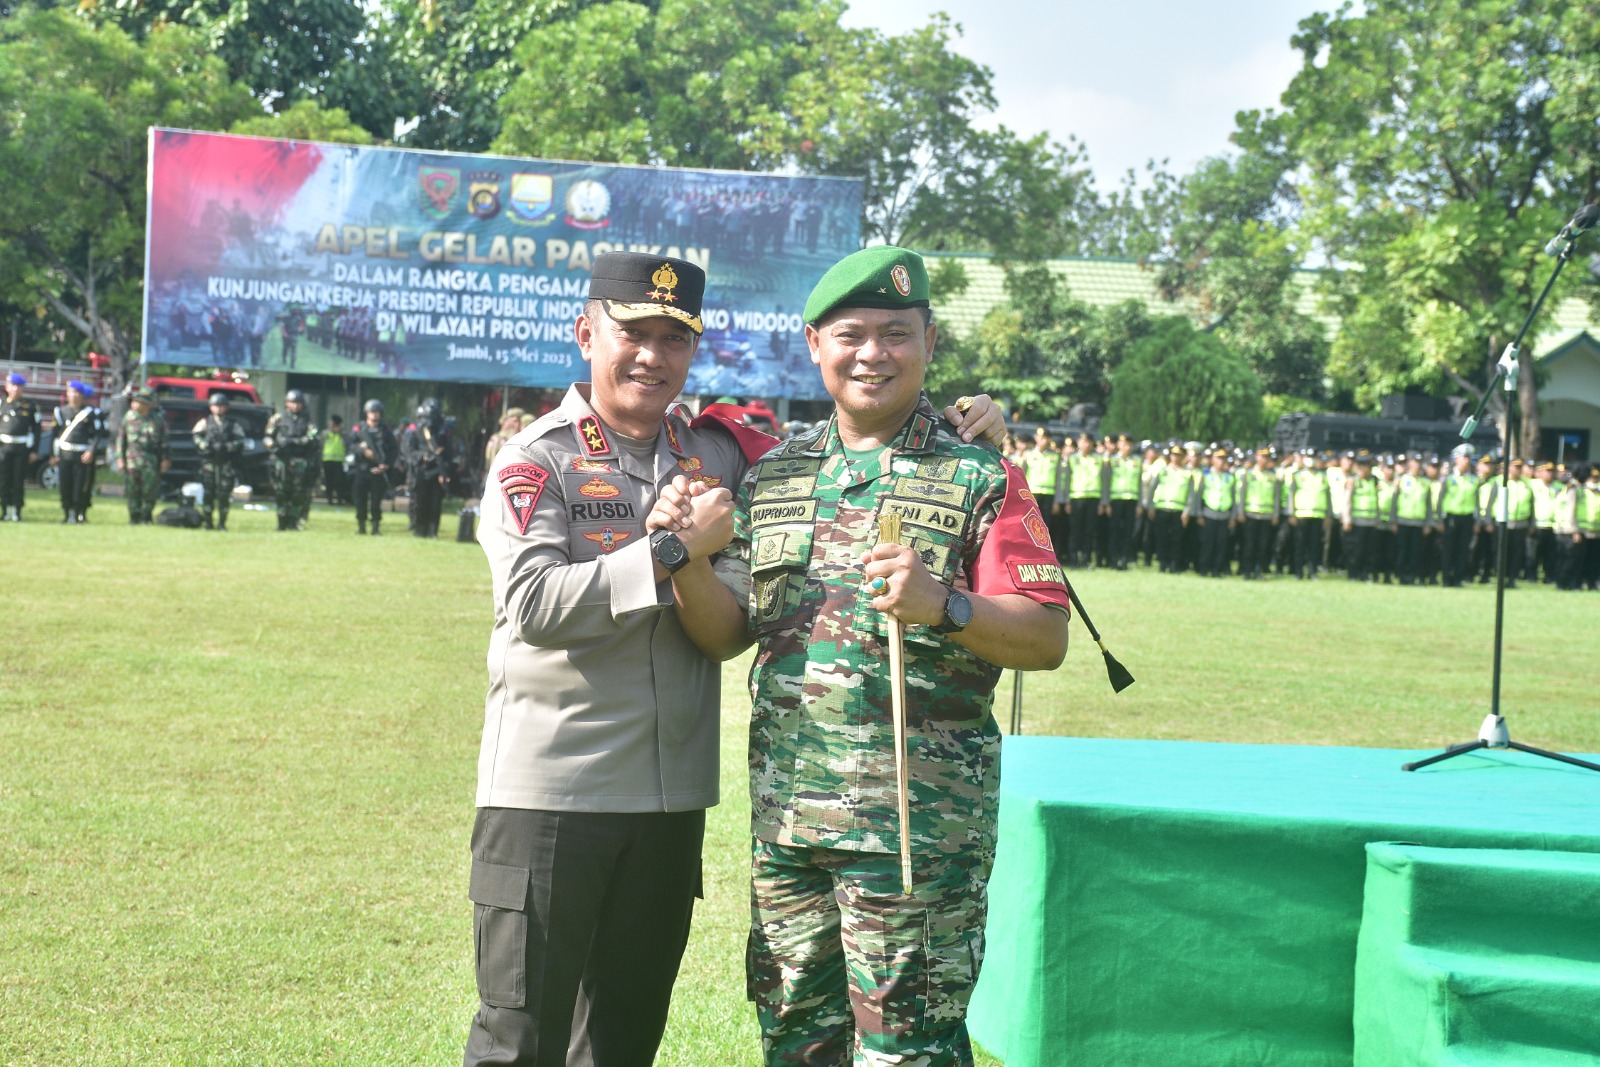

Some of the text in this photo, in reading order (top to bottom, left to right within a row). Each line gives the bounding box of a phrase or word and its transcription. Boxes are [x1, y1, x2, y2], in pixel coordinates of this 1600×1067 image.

[315, 223, 410, 260] APEL
[419, 231, 536, 268] GELAR
[334, 263, 591, 299] DALAM RANGKA PENGAMA
[207, 277, 317, 303] KUNJUNGAN
[323, 284, 375, 308] KERJA
[378, 290, 458, 314] PRESIDEN
[461, 296, 538, 319] REPUBLIK
[542, 300, 584, 321] INDO
[732, 309, 800, 334] WIDODO
[376, 311, 577, 344] DI WILAYAH PROVINS
[446, 343, 572, 368] Jambi, 15 Mei 2023
[500, 466, 543, 480] PELOPOR
[571, 502, 634, 521] RUSDI
[753, 505, 806, 522] SUPRIONO
[891, 505, 956, 528] TNI AD
[1017, 564, 1039, 583] DAN
